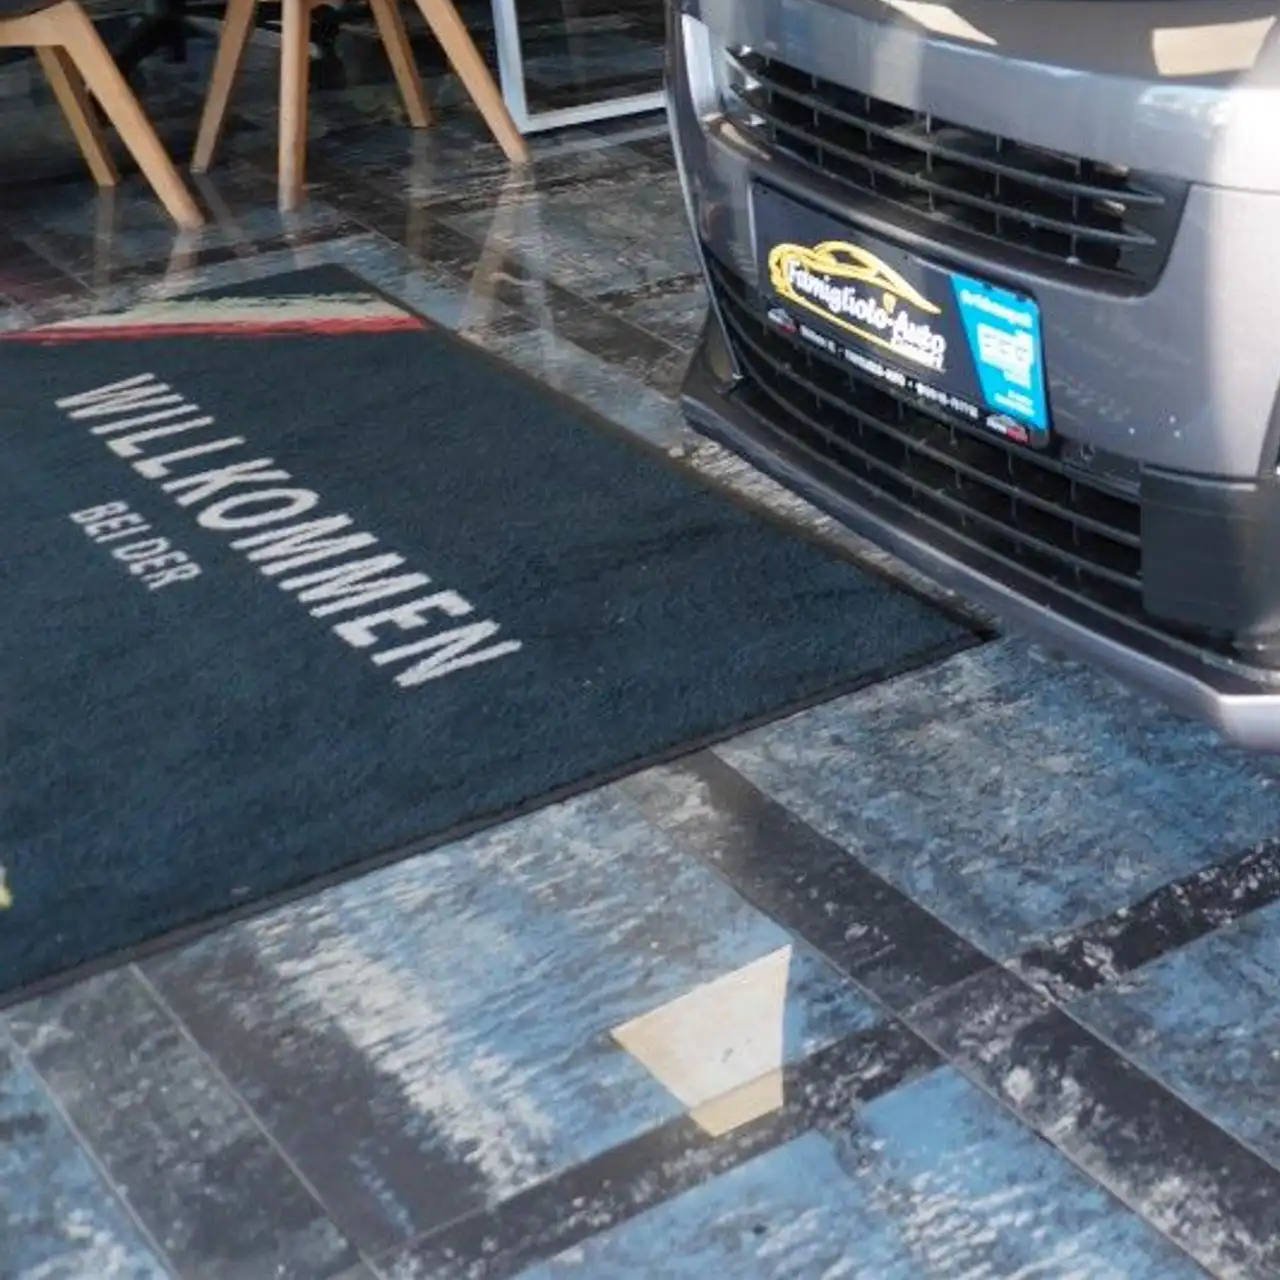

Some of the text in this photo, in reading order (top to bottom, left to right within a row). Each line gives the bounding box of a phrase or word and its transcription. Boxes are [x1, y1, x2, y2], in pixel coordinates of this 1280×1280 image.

[54, 372, 523, 689] WILLKOMMEN
[70, 499, 203, 592] BEI DER
